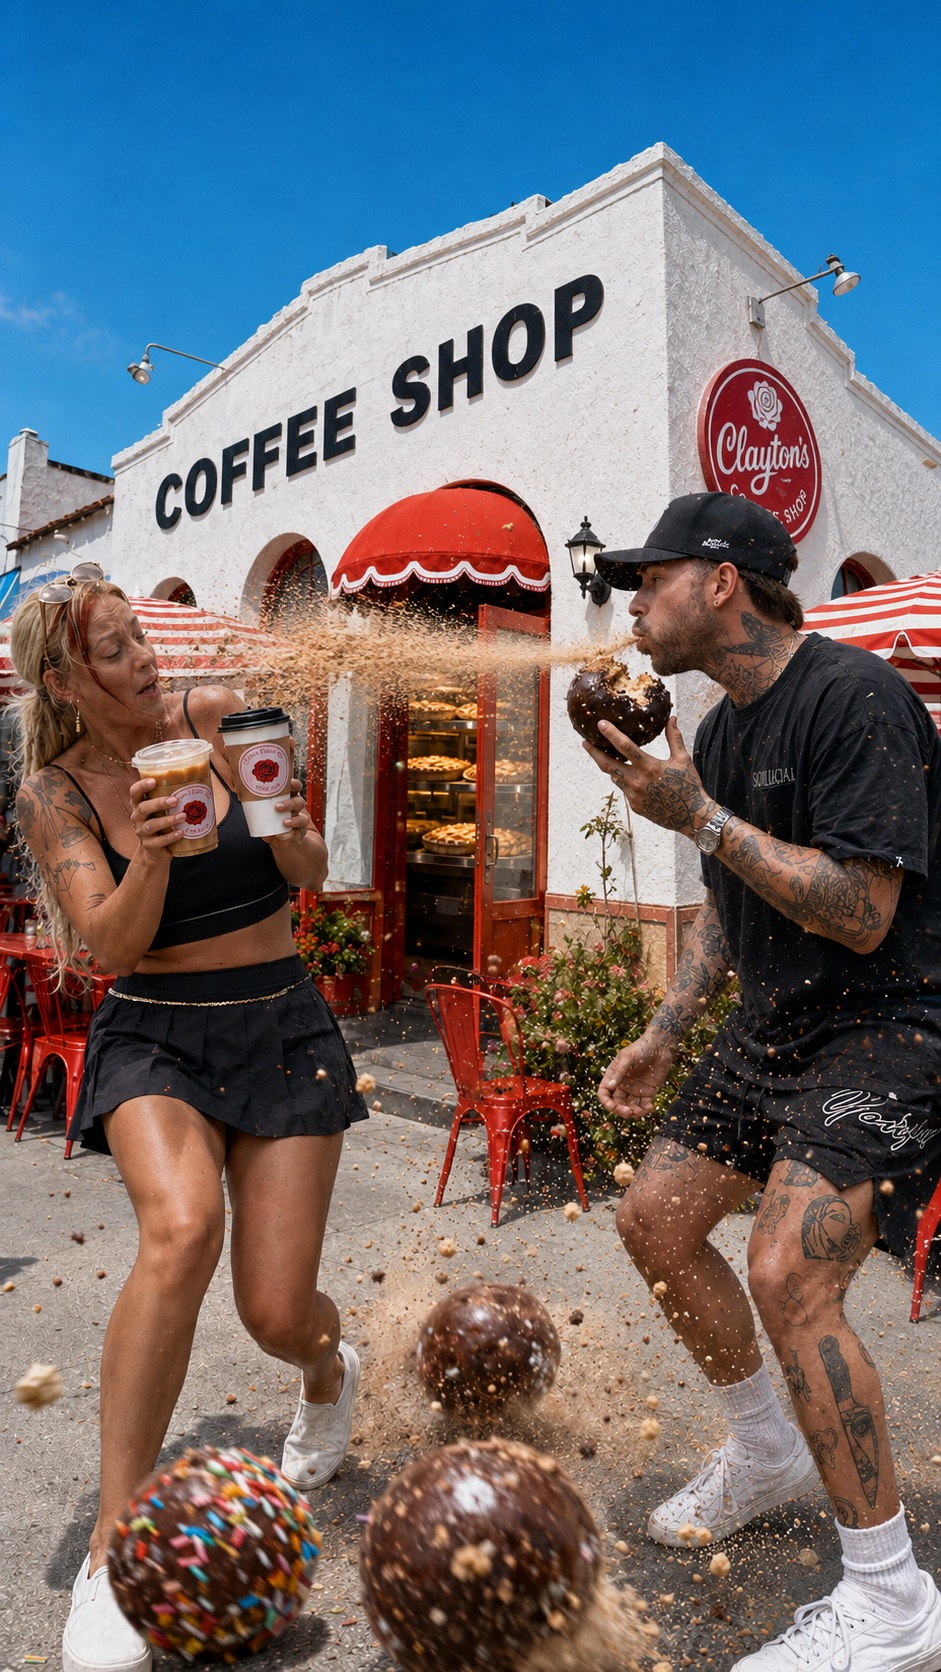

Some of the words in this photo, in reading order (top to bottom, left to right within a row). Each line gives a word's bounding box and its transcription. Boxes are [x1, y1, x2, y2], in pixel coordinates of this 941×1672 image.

[155, 387, 356, 530] COFFEE
[390, 274, 604, 427] SHOP
[717, 422, 809, 495] Clayton's
[784, 489, 806, 523] SHOP
